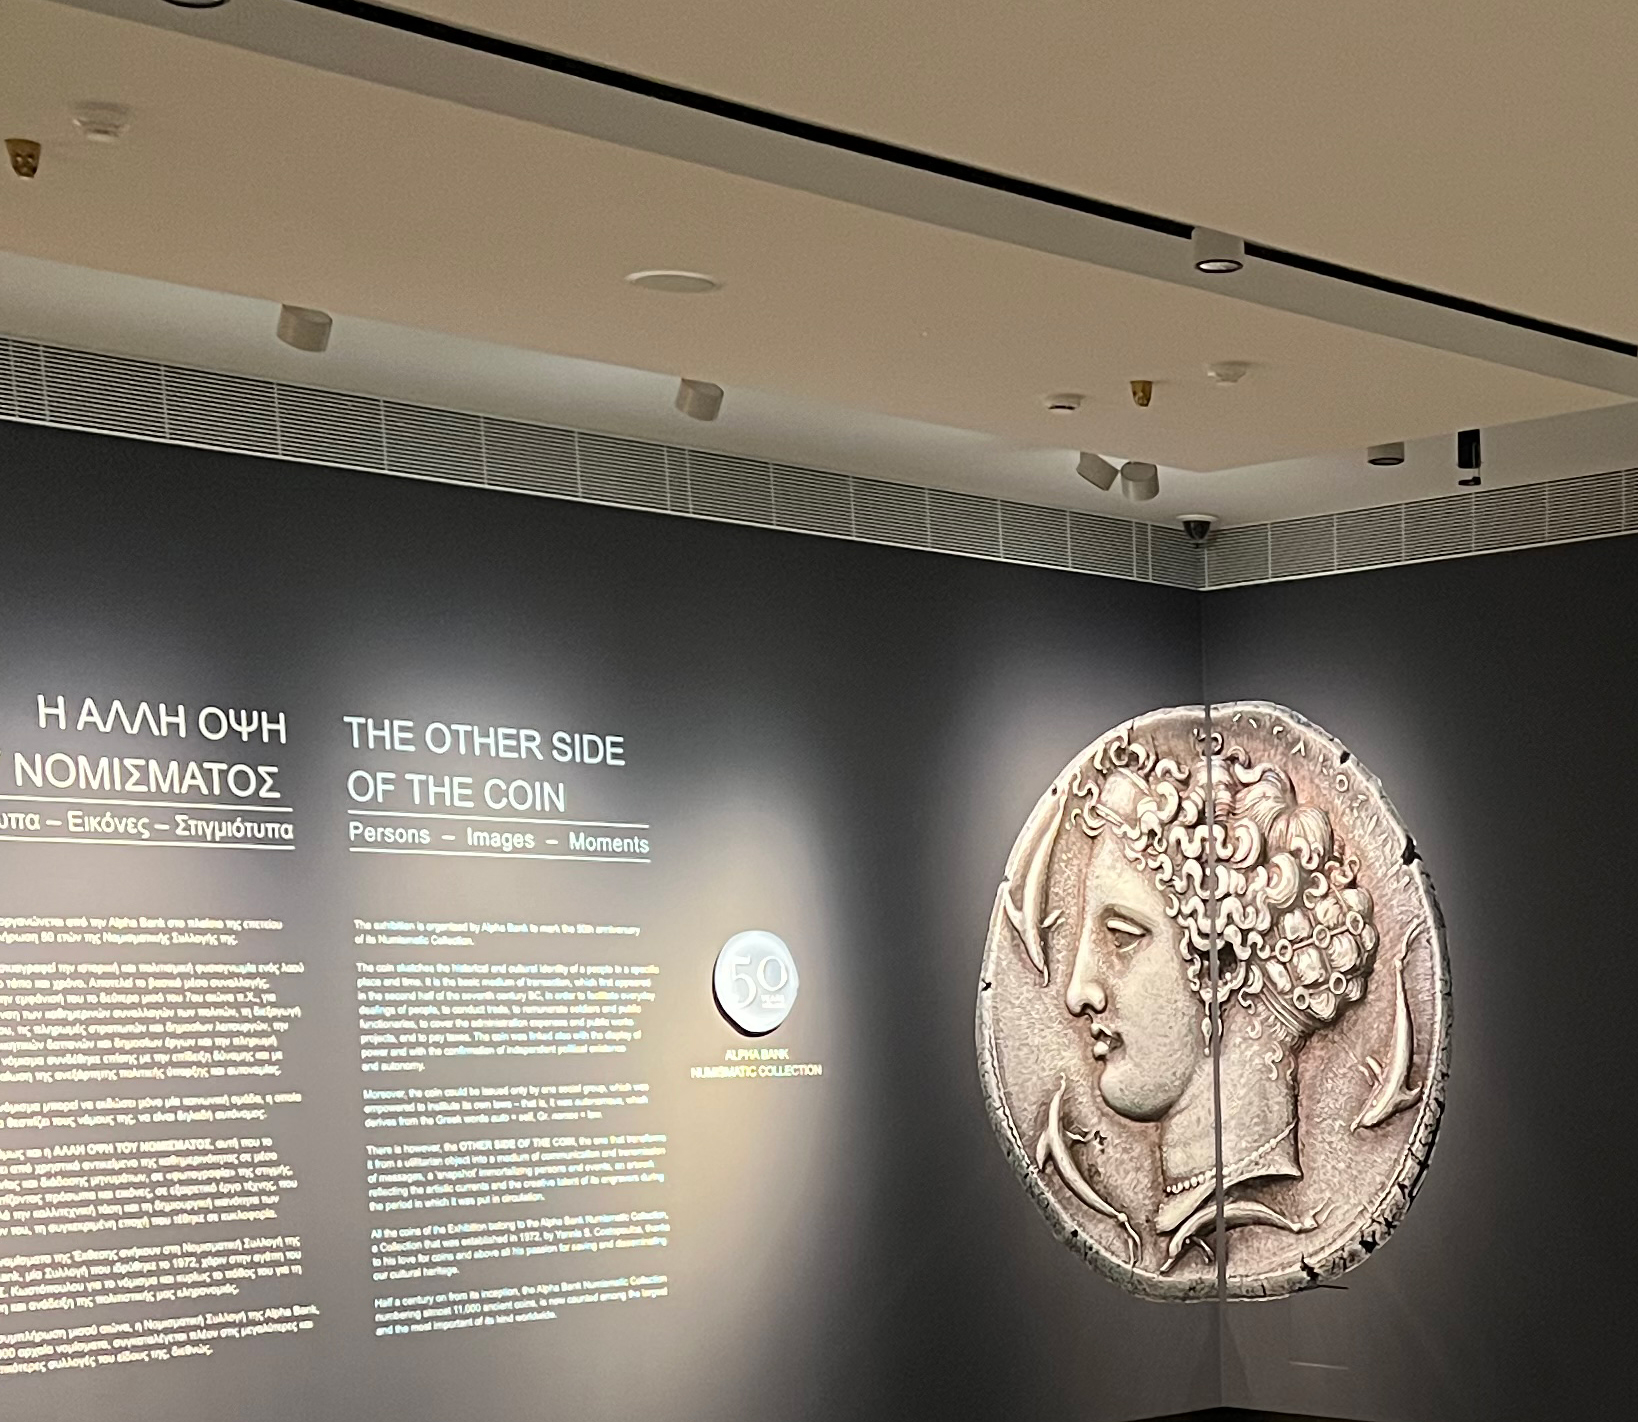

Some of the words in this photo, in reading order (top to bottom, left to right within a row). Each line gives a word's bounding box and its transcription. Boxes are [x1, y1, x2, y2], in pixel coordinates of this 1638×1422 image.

[37, 694, 67, 730] Η
[76, 697, 187, 738] ΑΛΛΗ
[198, 706, 287, 744] ΟΨΗ
[343, 716, 417, 752] THE
[425, 722, 544, 761] OTHER
[551, 730, 626, 766] SIDE
[14, 752, 281, 798] ΝΟΜΙΣΜΑΤΟΣ
[347, 770, 397, 803] OF
[404, 773, 475, 808] THE
[484, 778, 565, 813] COIN
[67, 810, 151, 838] Εικόνες
[175, 814, 294, 841] Στιγμιότυπα
[349, 821, 431, 845] Persons
[466, 826, 536, 852] Images
[568, 831, 650, 855] Moments
